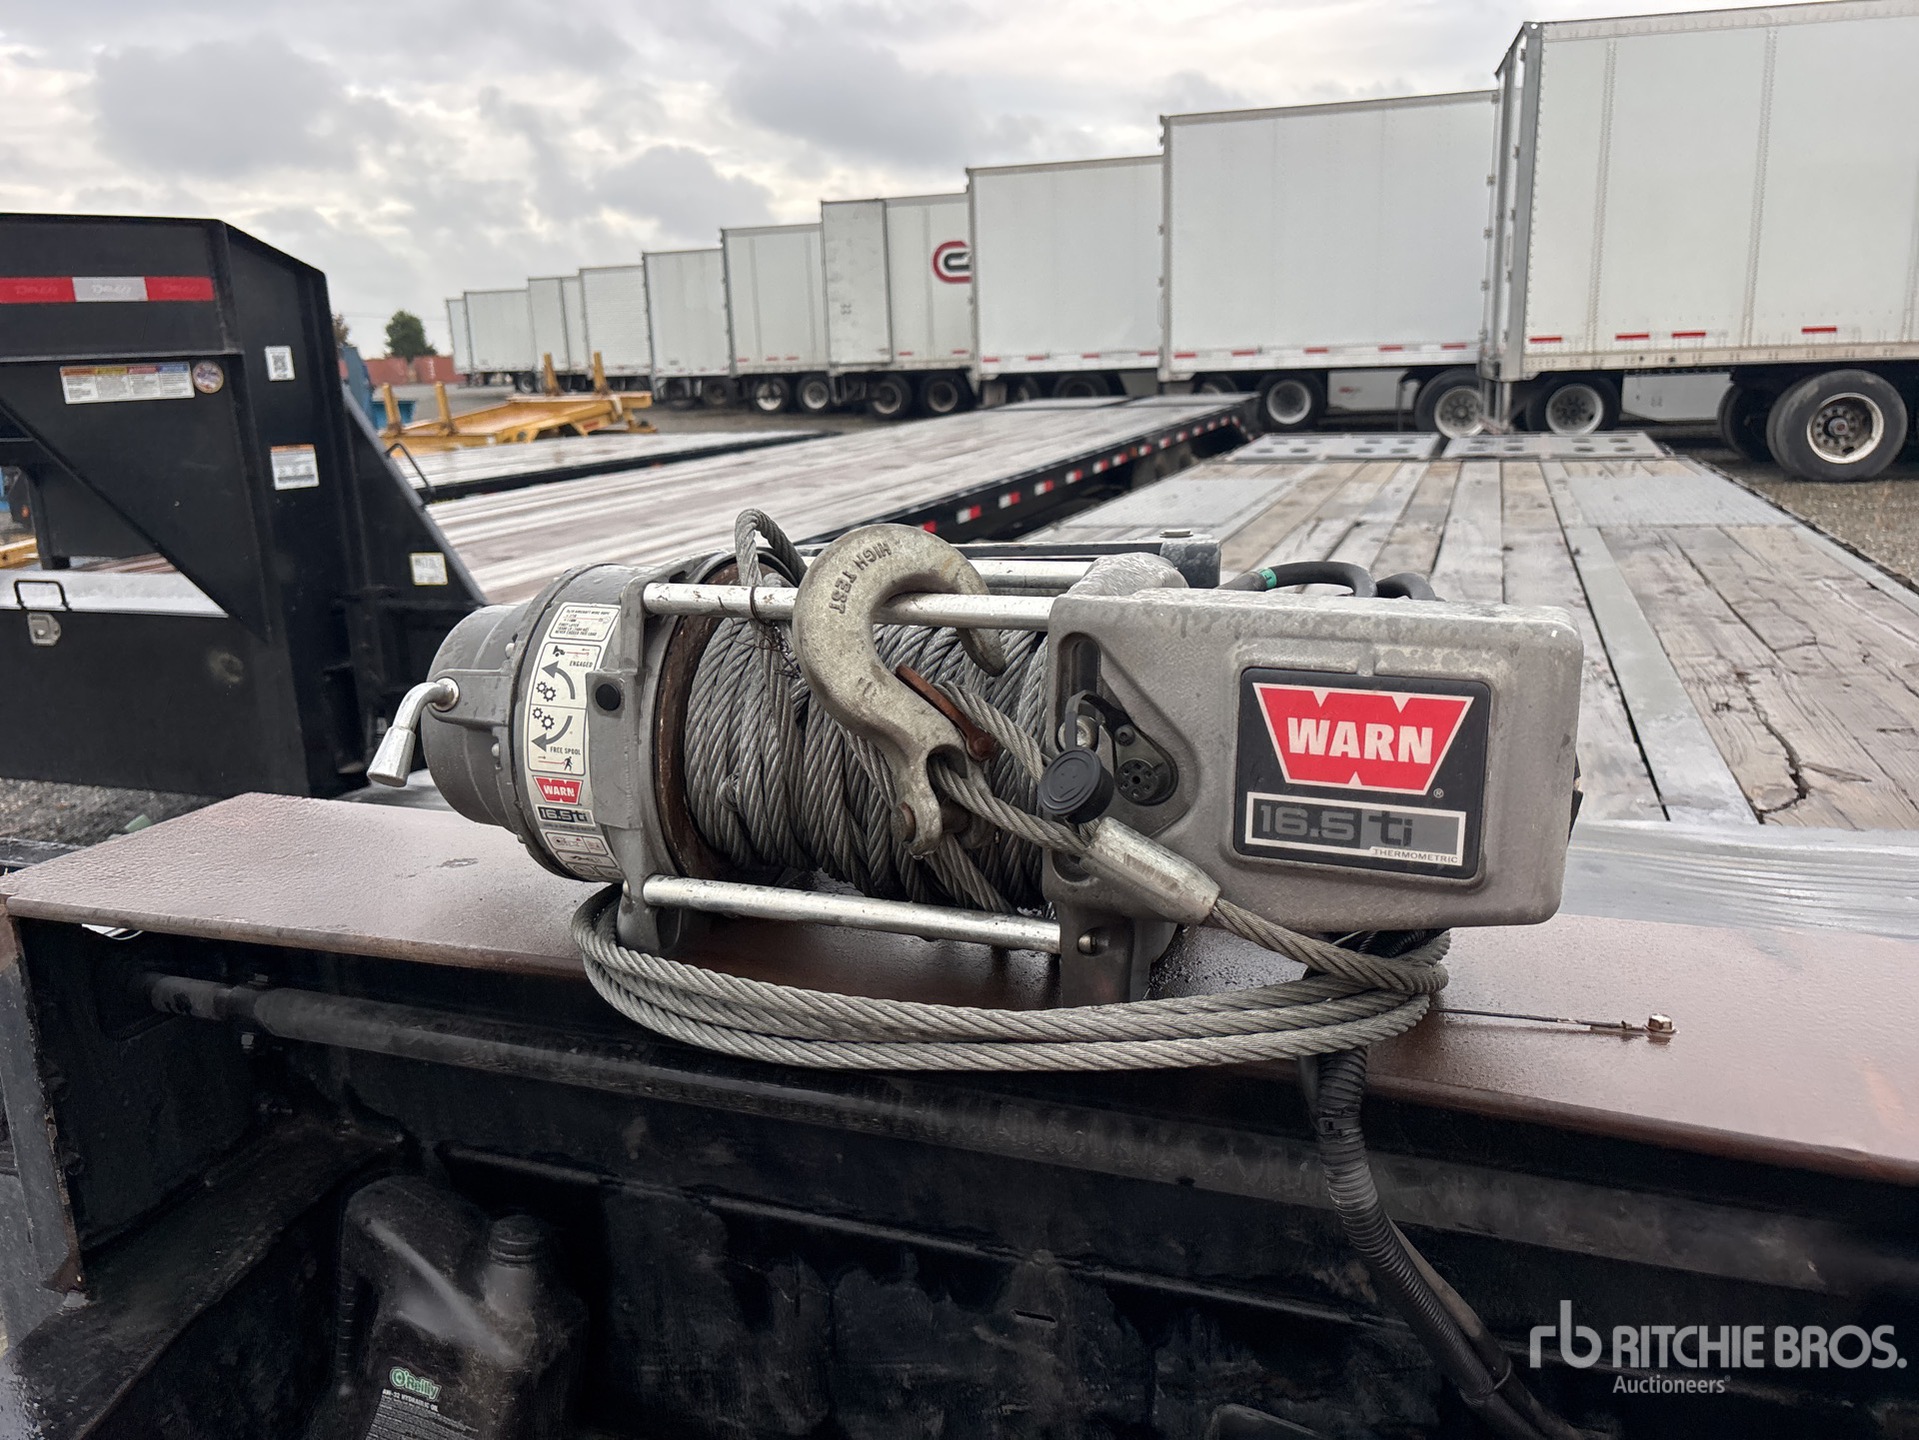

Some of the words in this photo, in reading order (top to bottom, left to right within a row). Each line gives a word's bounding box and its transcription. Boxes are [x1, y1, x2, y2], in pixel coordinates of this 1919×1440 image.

[853, 542, 892, 571] HIGH
[828, 570, 858, 614] TEST
[569, 660, 594, 668] ENGAGED
[564, 747, 581, 755] SPOOL
[1287, 716, 1434, 765] WARN
[543, 784, 575, 797] WARN
[1373, 848, 1459, 864] THERMOMETRIC
[391, 1368, 440, 1400] O'Reilly
